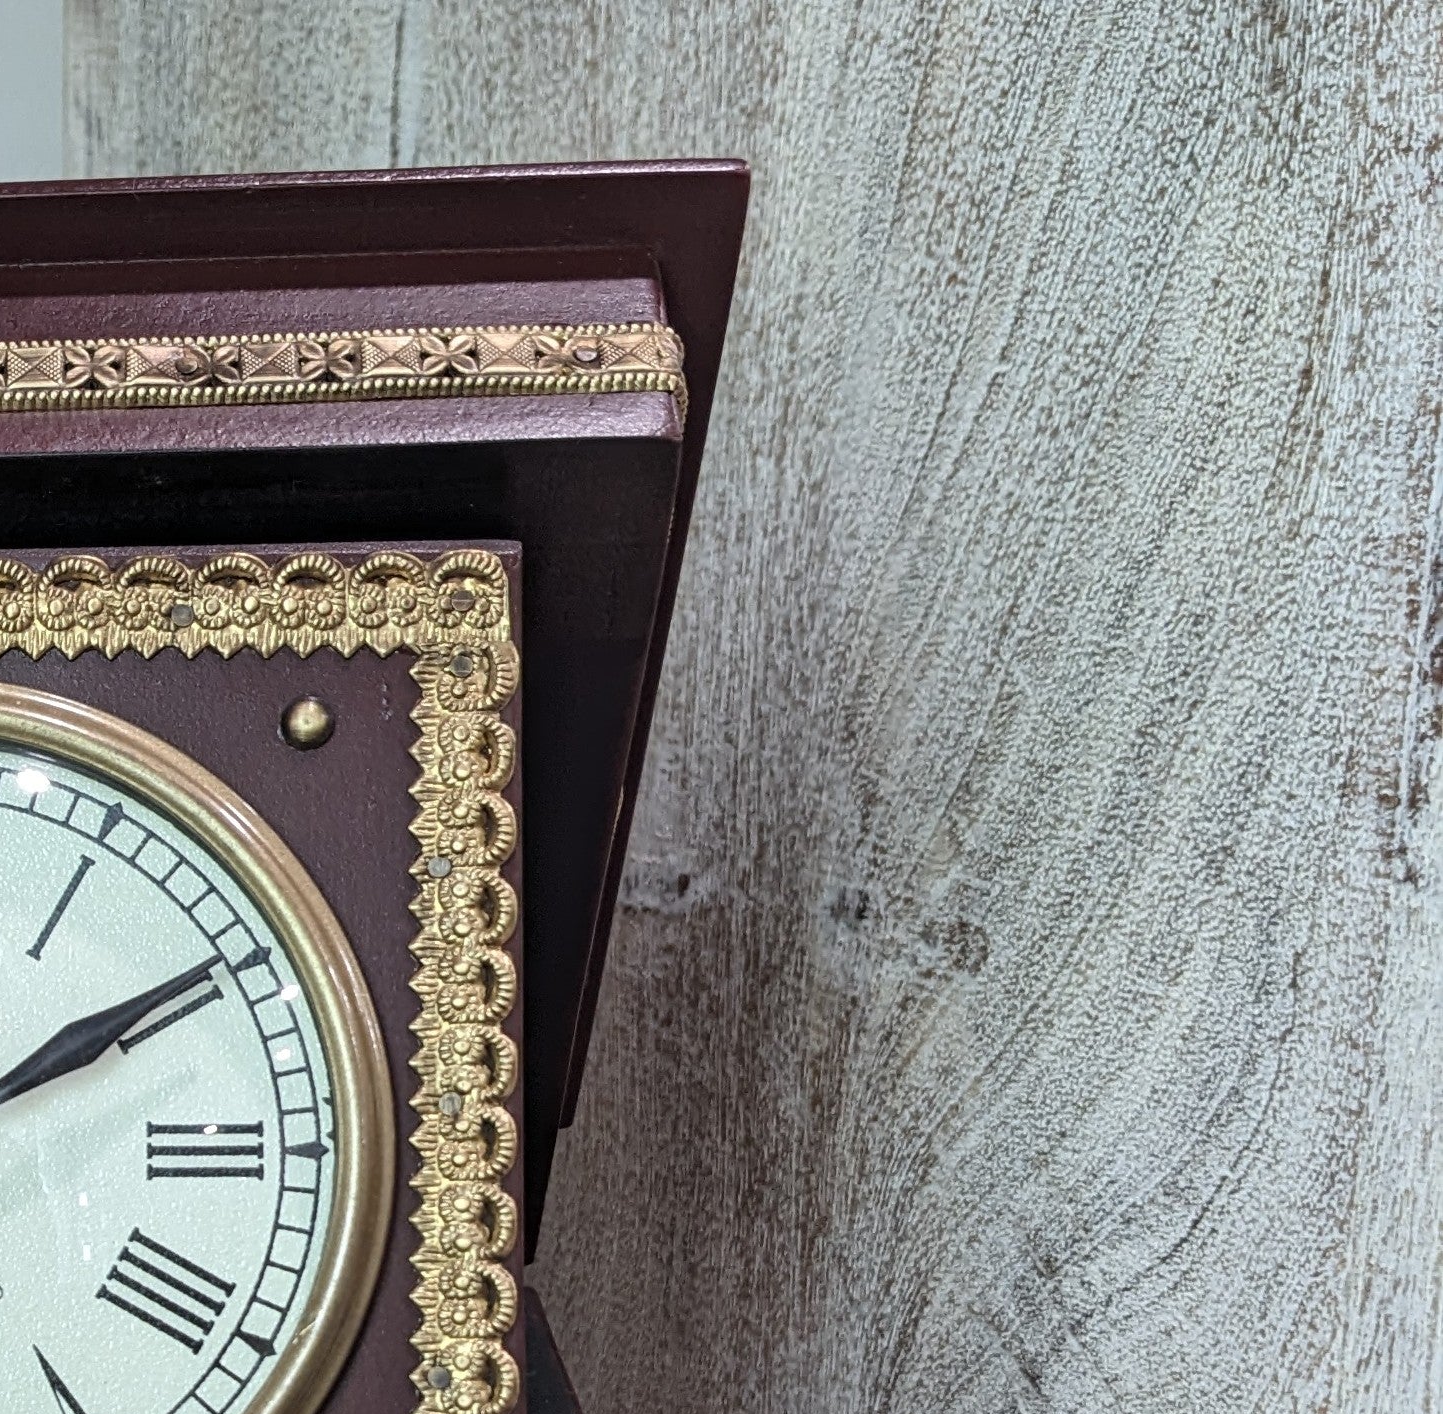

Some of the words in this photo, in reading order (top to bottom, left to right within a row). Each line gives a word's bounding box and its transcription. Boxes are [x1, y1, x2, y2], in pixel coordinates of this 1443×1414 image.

[26, 854, 95, 960] I
[116, 967, 224, 1056] I
[146, 1119, 265, 1181] III
[96, 1227, 236, 1355] IIII
